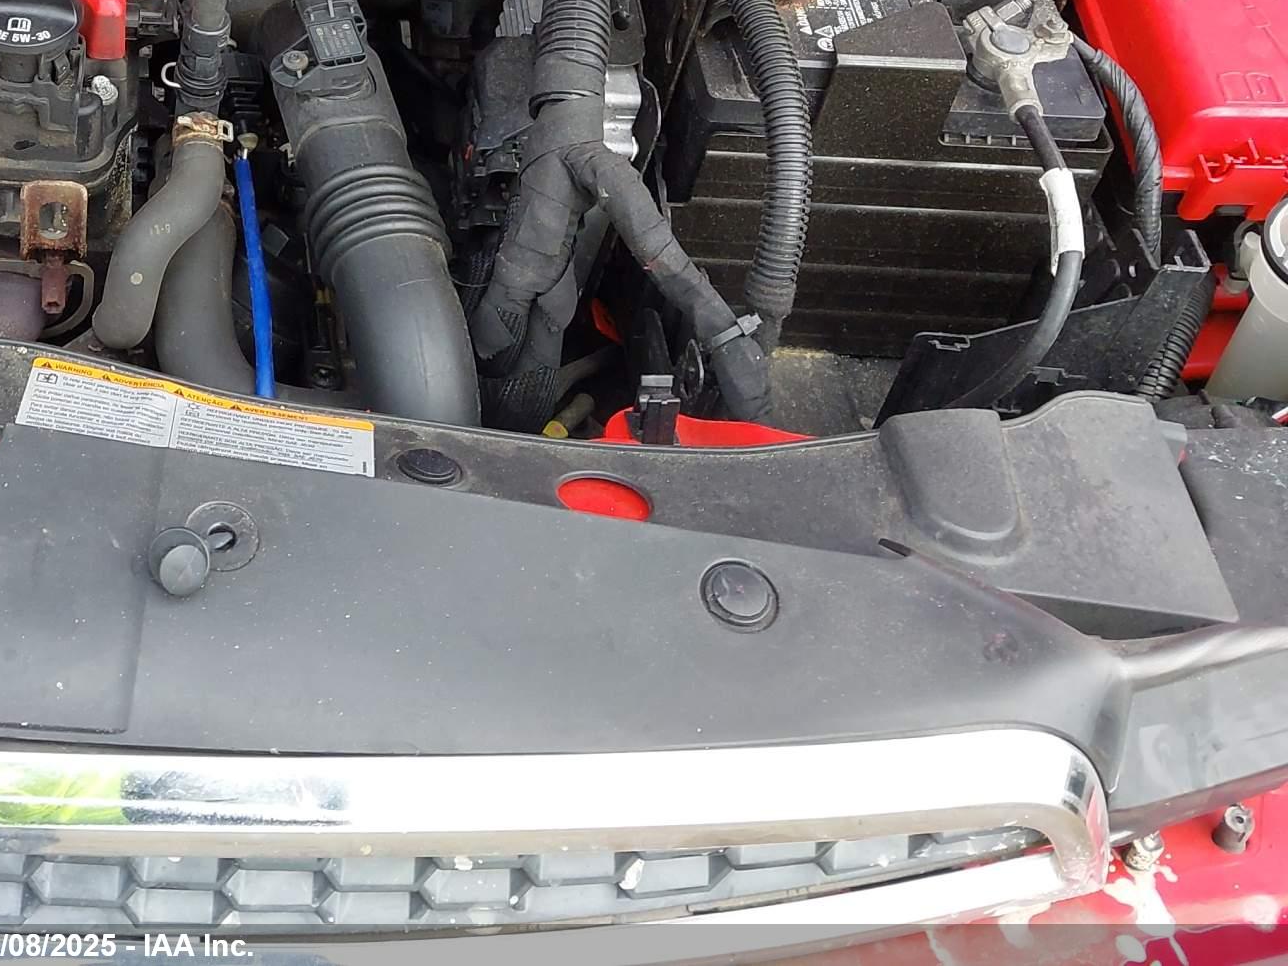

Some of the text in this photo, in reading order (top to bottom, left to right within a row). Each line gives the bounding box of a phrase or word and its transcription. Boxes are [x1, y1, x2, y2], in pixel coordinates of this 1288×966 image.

[11, 30, 51, 43] 5W-30
[55, 363, 93, 376] WARNING
[113, 376, 165, 389] ADVERTENCIA
[186, 393, 225, 407] ATENÇÃO
[244, 406, 309, 421] AVERTISSEMENT
